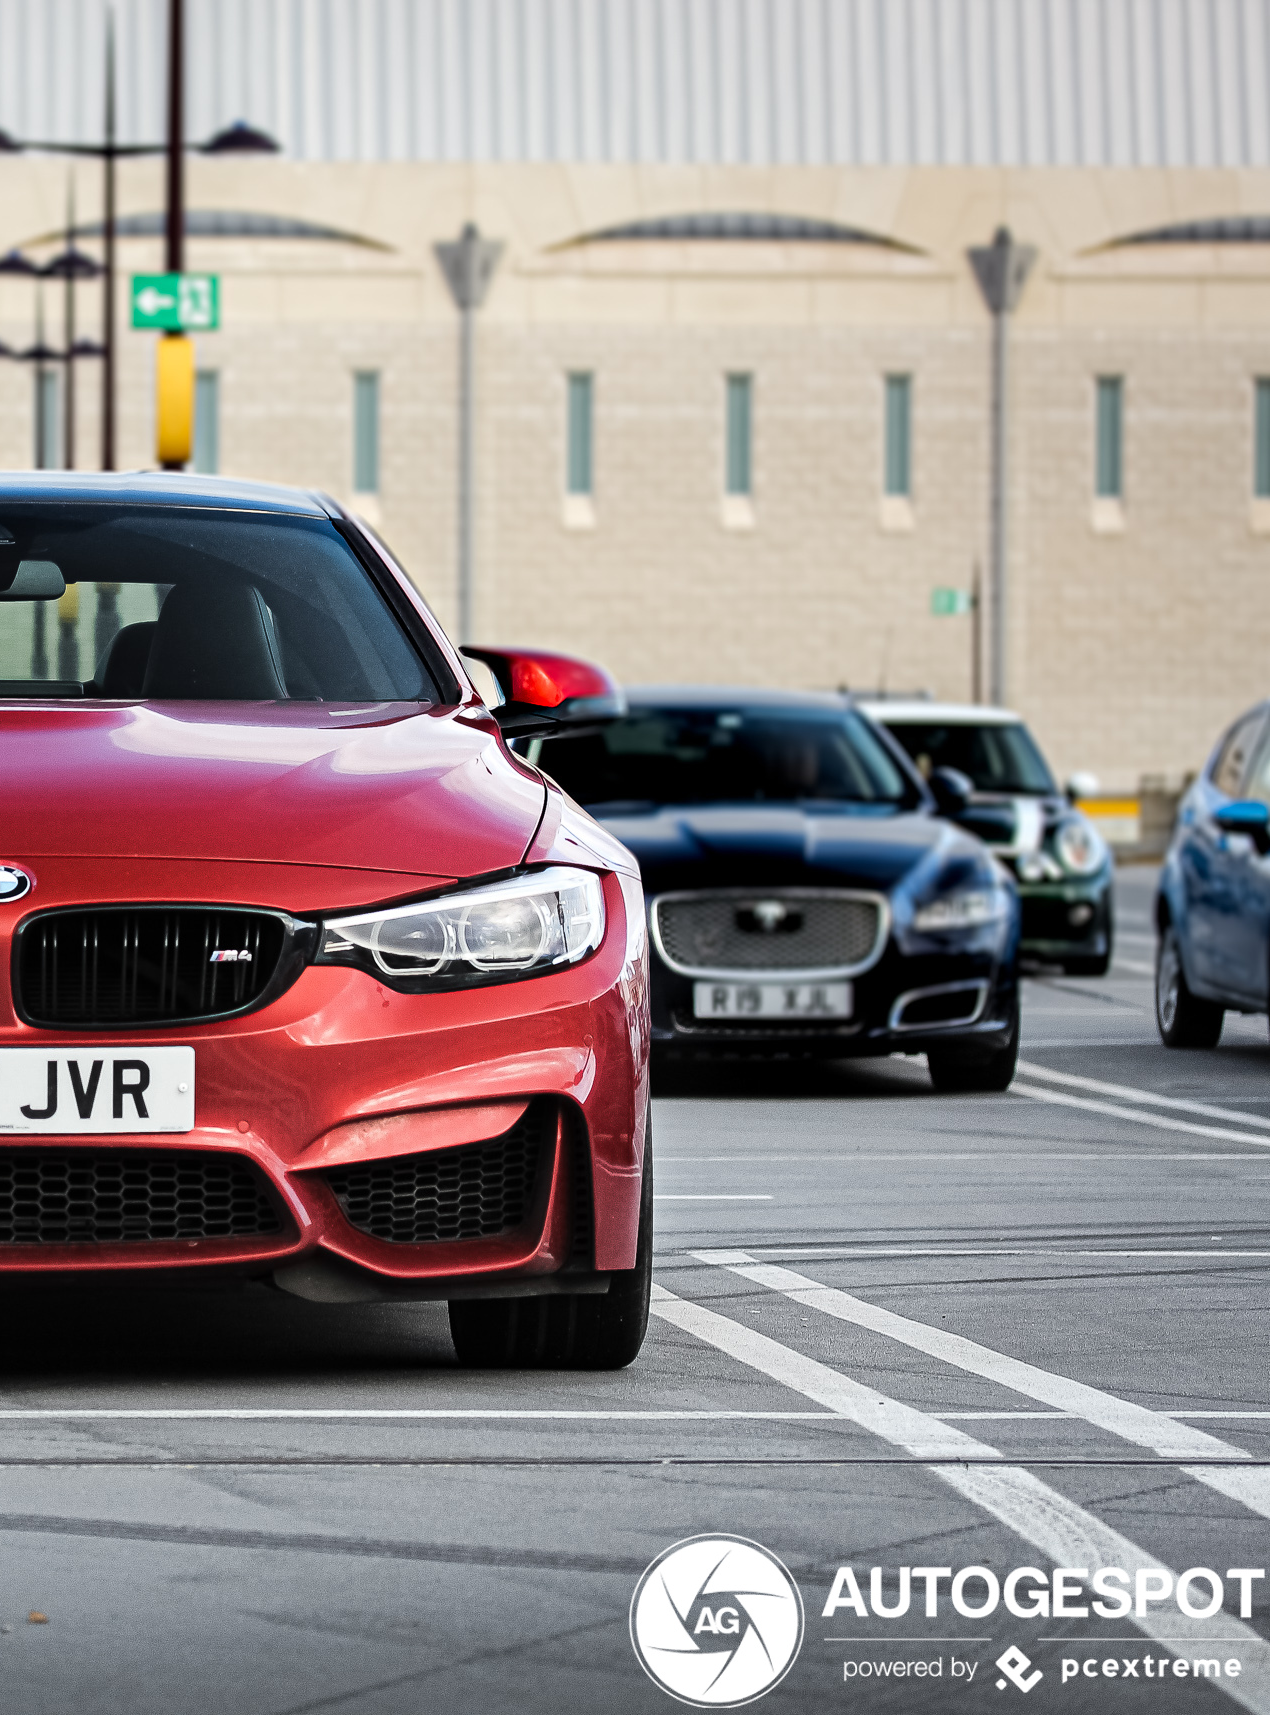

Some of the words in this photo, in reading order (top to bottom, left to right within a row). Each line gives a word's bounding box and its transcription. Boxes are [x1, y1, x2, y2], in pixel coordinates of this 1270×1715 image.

[221, 949, 253, 962] M4
[711, 986, 763, 1013] R19
[19, 1059, 151, 1120] JVR
